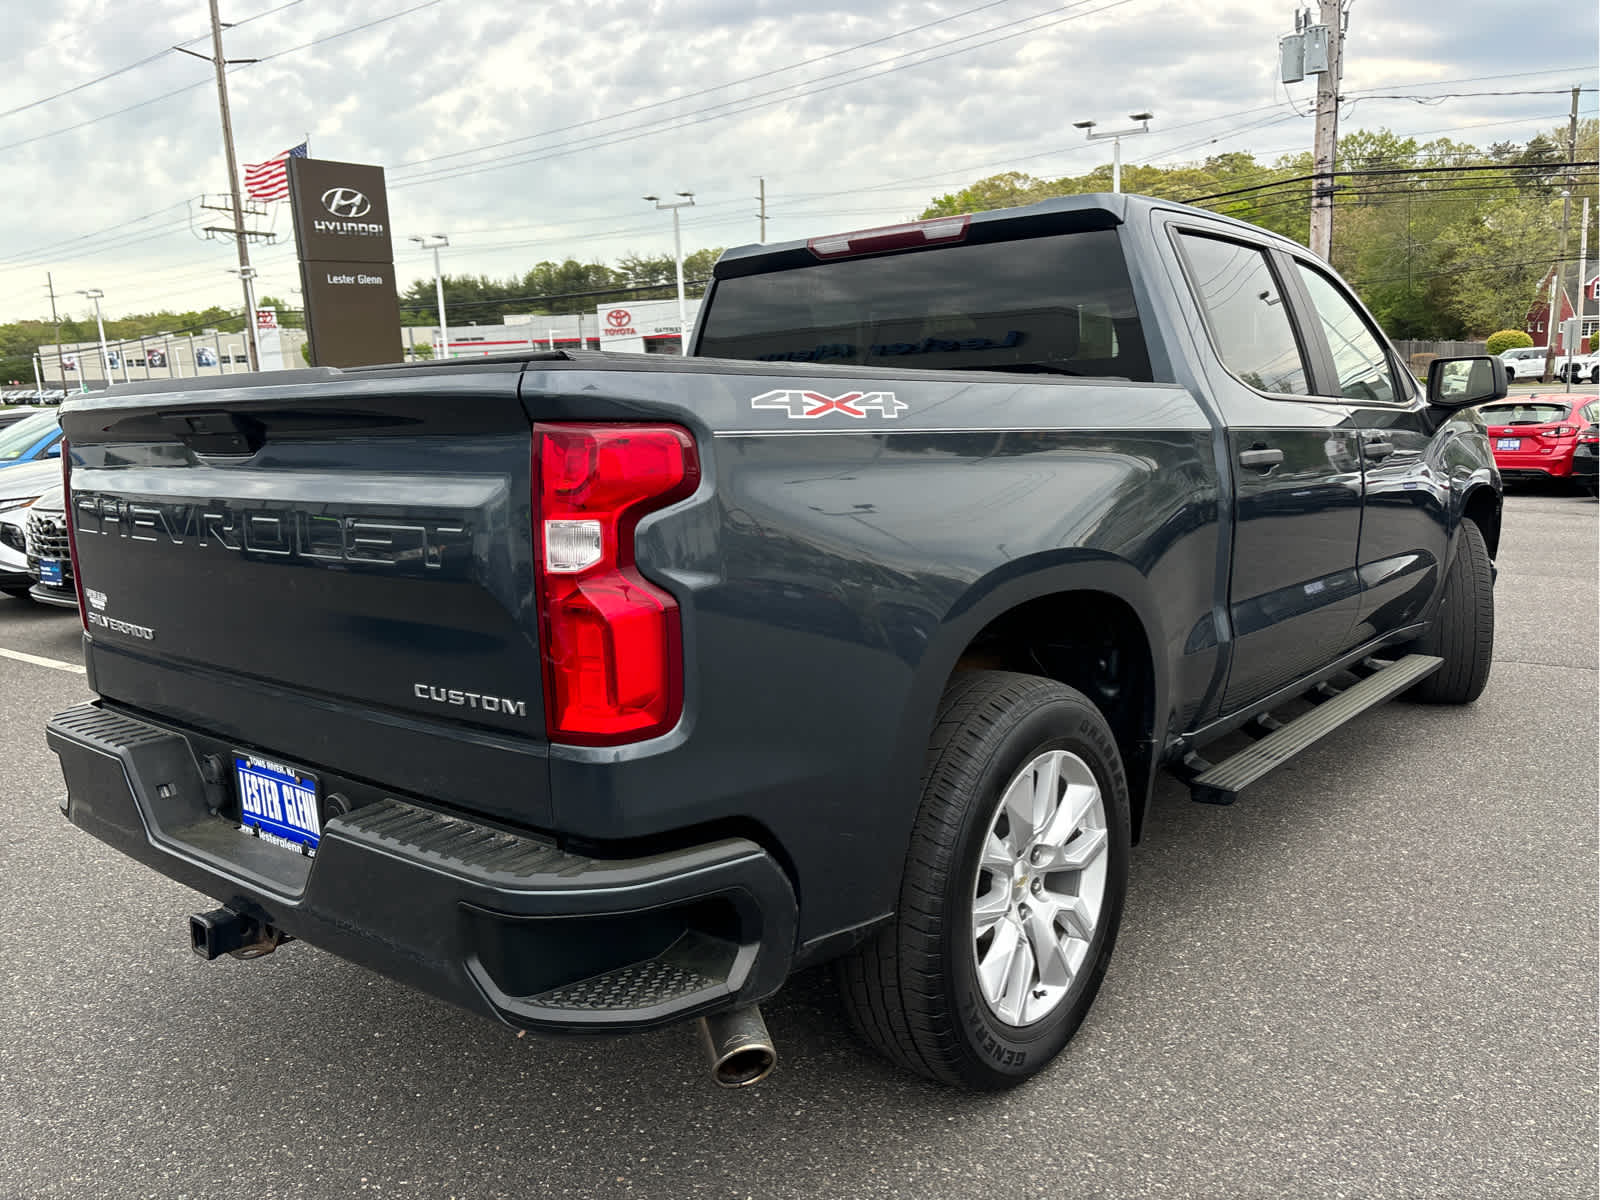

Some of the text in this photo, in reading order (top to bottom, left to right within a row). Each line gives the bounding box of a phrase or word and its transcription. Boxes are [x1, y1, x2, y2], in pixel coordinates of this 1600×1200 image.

[314, 220, 384, 236] HYUNDAI
[327, 274, 383, 285] Lester Glenn
[604, 327, 637, 336] TOYOTA
[75, 495, 467, 568] CHEVROLET
[88, 611, 154, 640] SILVERADO
[414, 683, 526, 717] CUSTOM
[249, 756, 267, 769] TOMS
[239, 770, 320, 836] LESTER GLENN
